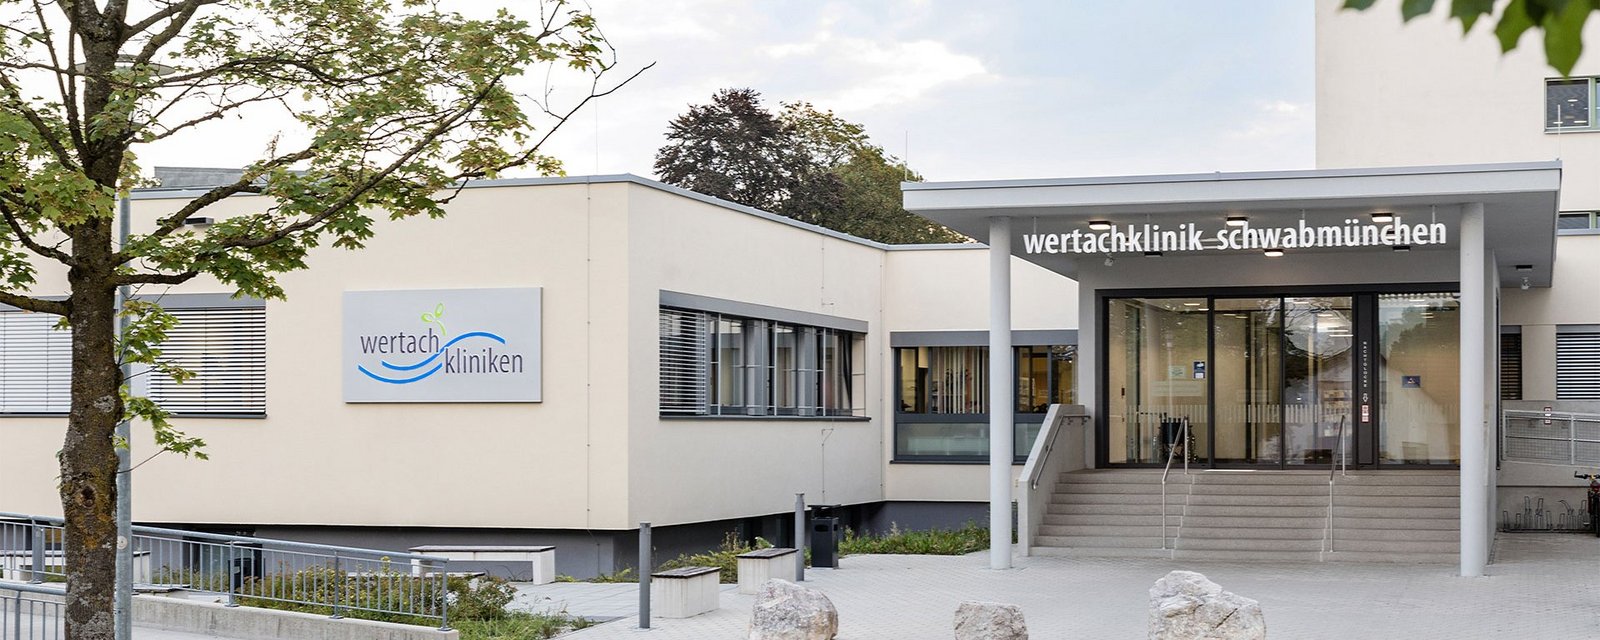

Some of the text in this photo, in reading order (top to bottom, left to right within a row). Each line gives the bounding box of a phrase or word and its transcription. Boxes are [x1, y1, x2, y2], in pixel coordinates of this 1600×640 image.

[1023, 216, 1447, 254] wertachklinik schwabmünchen
[360, 327, 439, 354] wertach
[445, 347, 523, 374] kliniken
